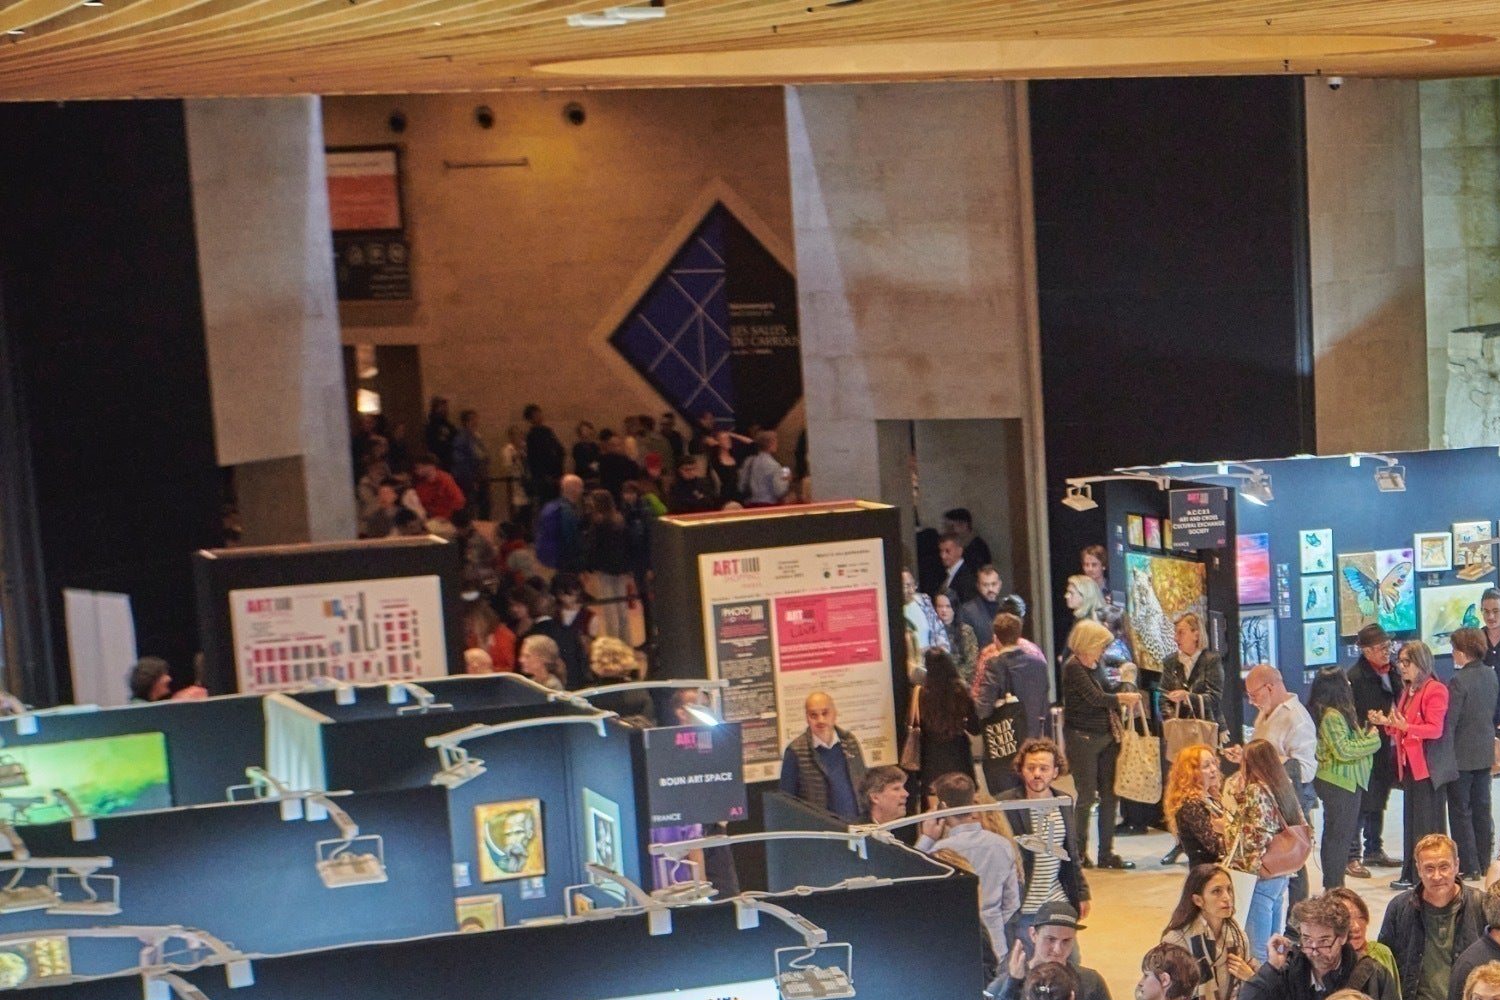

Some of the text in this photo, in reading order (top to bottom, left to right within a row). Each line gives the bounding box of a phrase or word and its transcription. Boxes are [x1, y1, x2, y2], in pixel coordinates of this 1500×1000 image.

[712, 558, 739, 577] ART
[659, 771, 733, 787] BOUN ART SPACE
[651, 813, 682, 822] FRANCE
